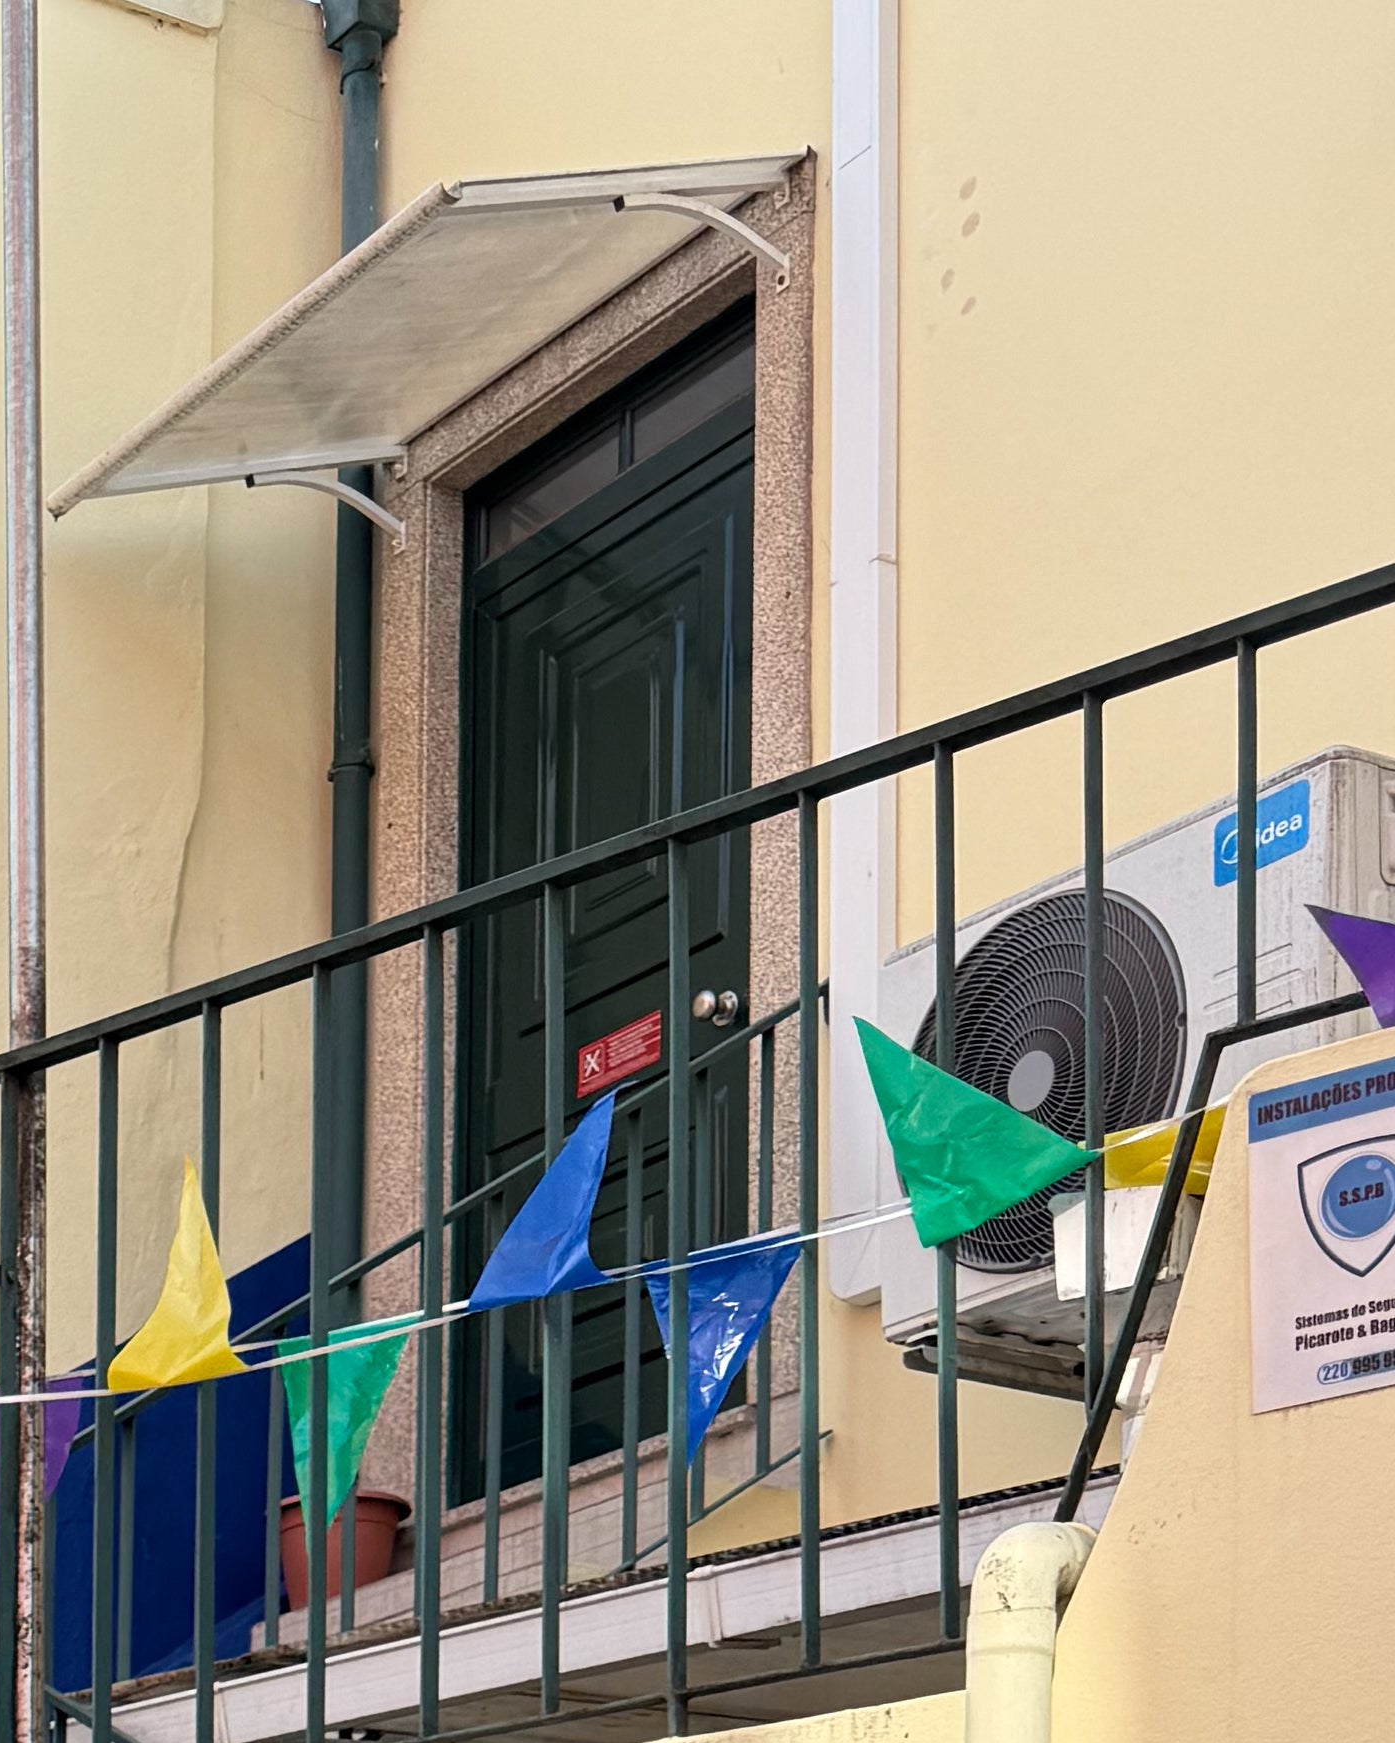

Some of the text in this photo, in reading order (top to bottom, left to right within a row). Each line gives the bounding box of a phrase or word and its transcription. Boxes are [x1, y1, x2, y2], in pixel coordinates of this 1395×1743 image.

[1257, 1081, 1362, 1126] INSTALAÇÕES
[1339, 1182, 1384, 1207] S.S.P.B
[1295, 1308, 1350, 1330] Sistemas
[1352, 1304, 1366, 1317] de
[1295, 1327, 1354, 1352] Picarote
[1357, 1324, 1367, 1338] &
[1322, 1361, 1349, 1381] 220
[1352, 1353, 1380, 1375] 995
